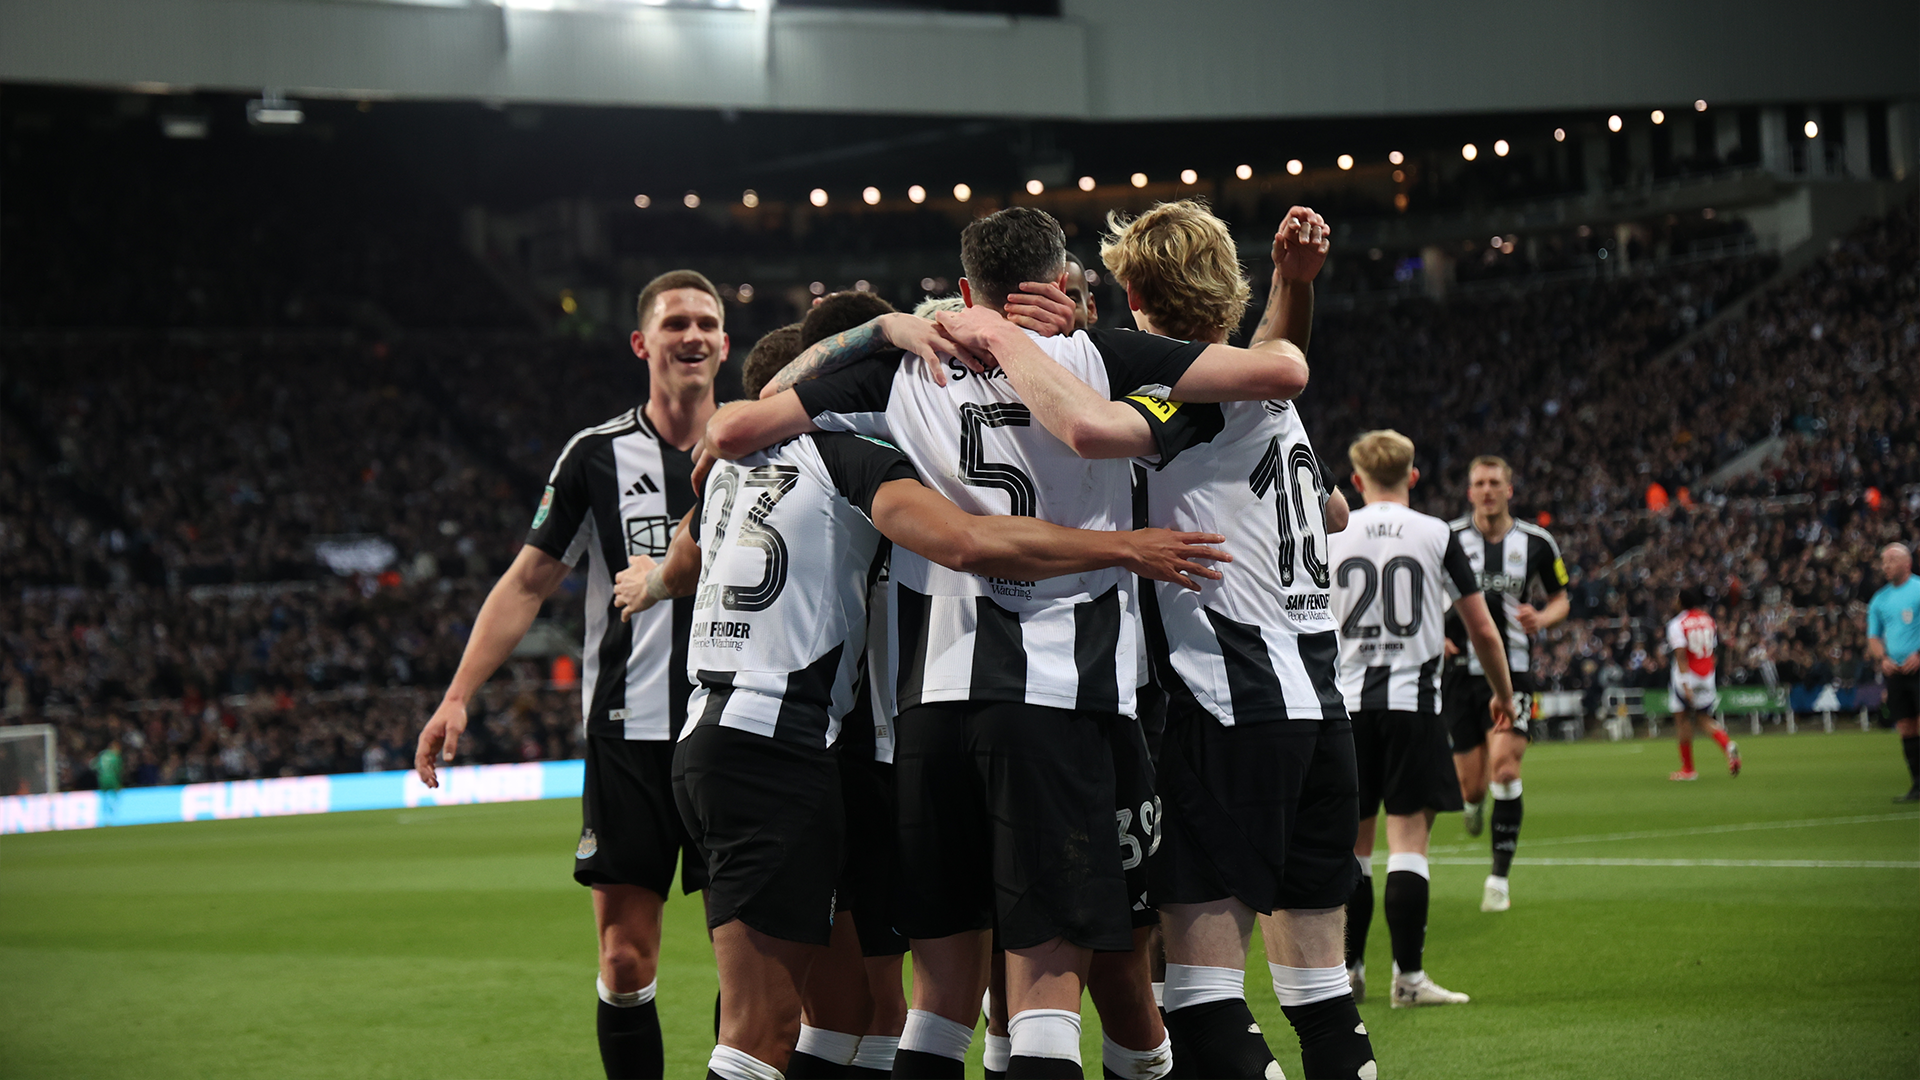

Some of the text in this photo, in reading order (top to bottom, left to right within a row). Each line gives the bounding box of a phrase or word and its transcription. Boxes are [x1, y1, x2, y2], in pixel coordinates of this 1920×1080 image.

[957, 402, 1036, 518] 5
[694, 465, 800, 612] 23
[1249, 435, 1331, 589] 10
[1365, 523, 1404, 540] HALL
[991, 584, 1033, 601] Watching
[1285, 594, 1307, 611] SAM
[1337, 555, 1424, 639] 20
[710, 621, 751, 639] FENDER
[180, 774, 330, 822] FUN88
[1116, 795, 1162, 871] 39
